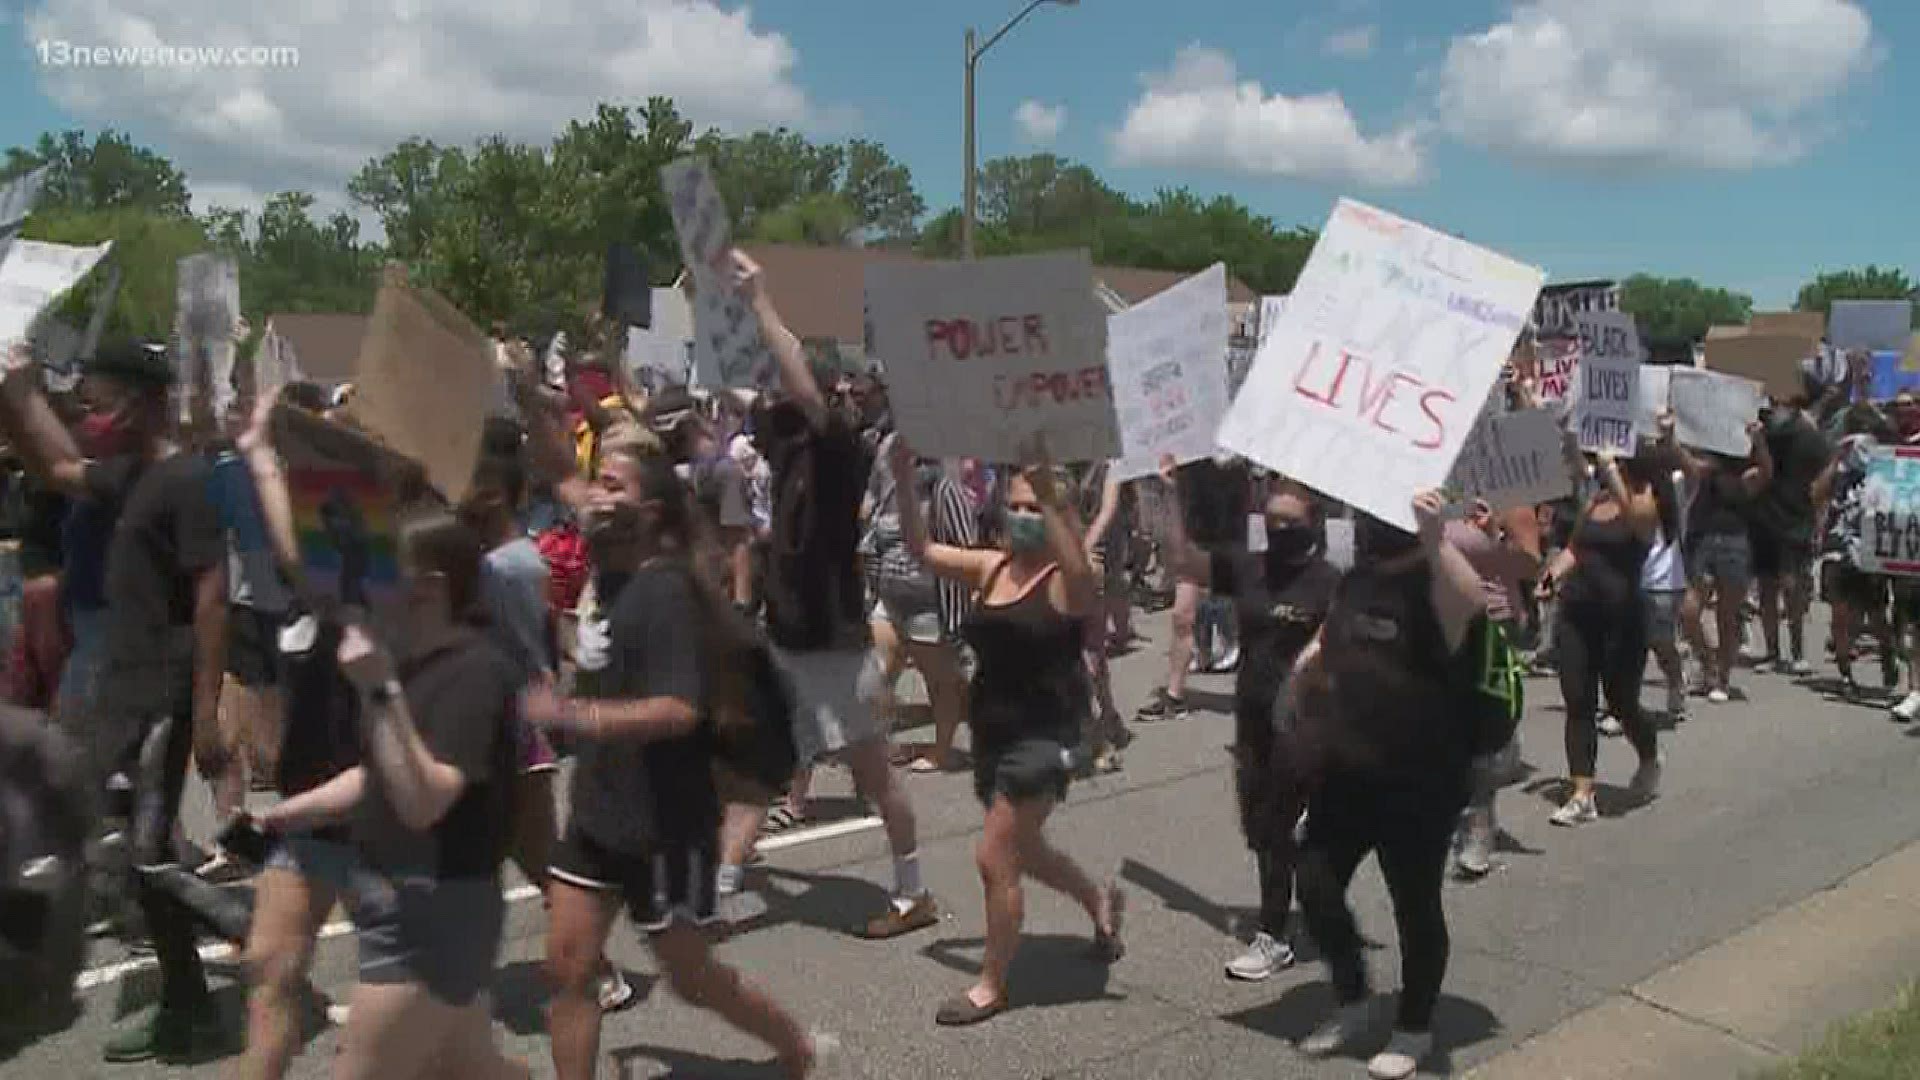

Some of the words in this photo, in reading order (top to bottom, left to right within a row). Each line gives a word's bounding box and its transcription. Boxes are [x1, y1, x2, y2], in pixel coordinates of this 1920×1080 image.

[925, 313, 1050, 361] POWER
[1539, 357, 1578, 379] LIV
[1588, 363, 1630, 401] LIVES
[1294, 340, 1457, 450] LIVES
[1874, 511, 1920, 532] BLA
[1874, 532, 1920, 557] LIV
